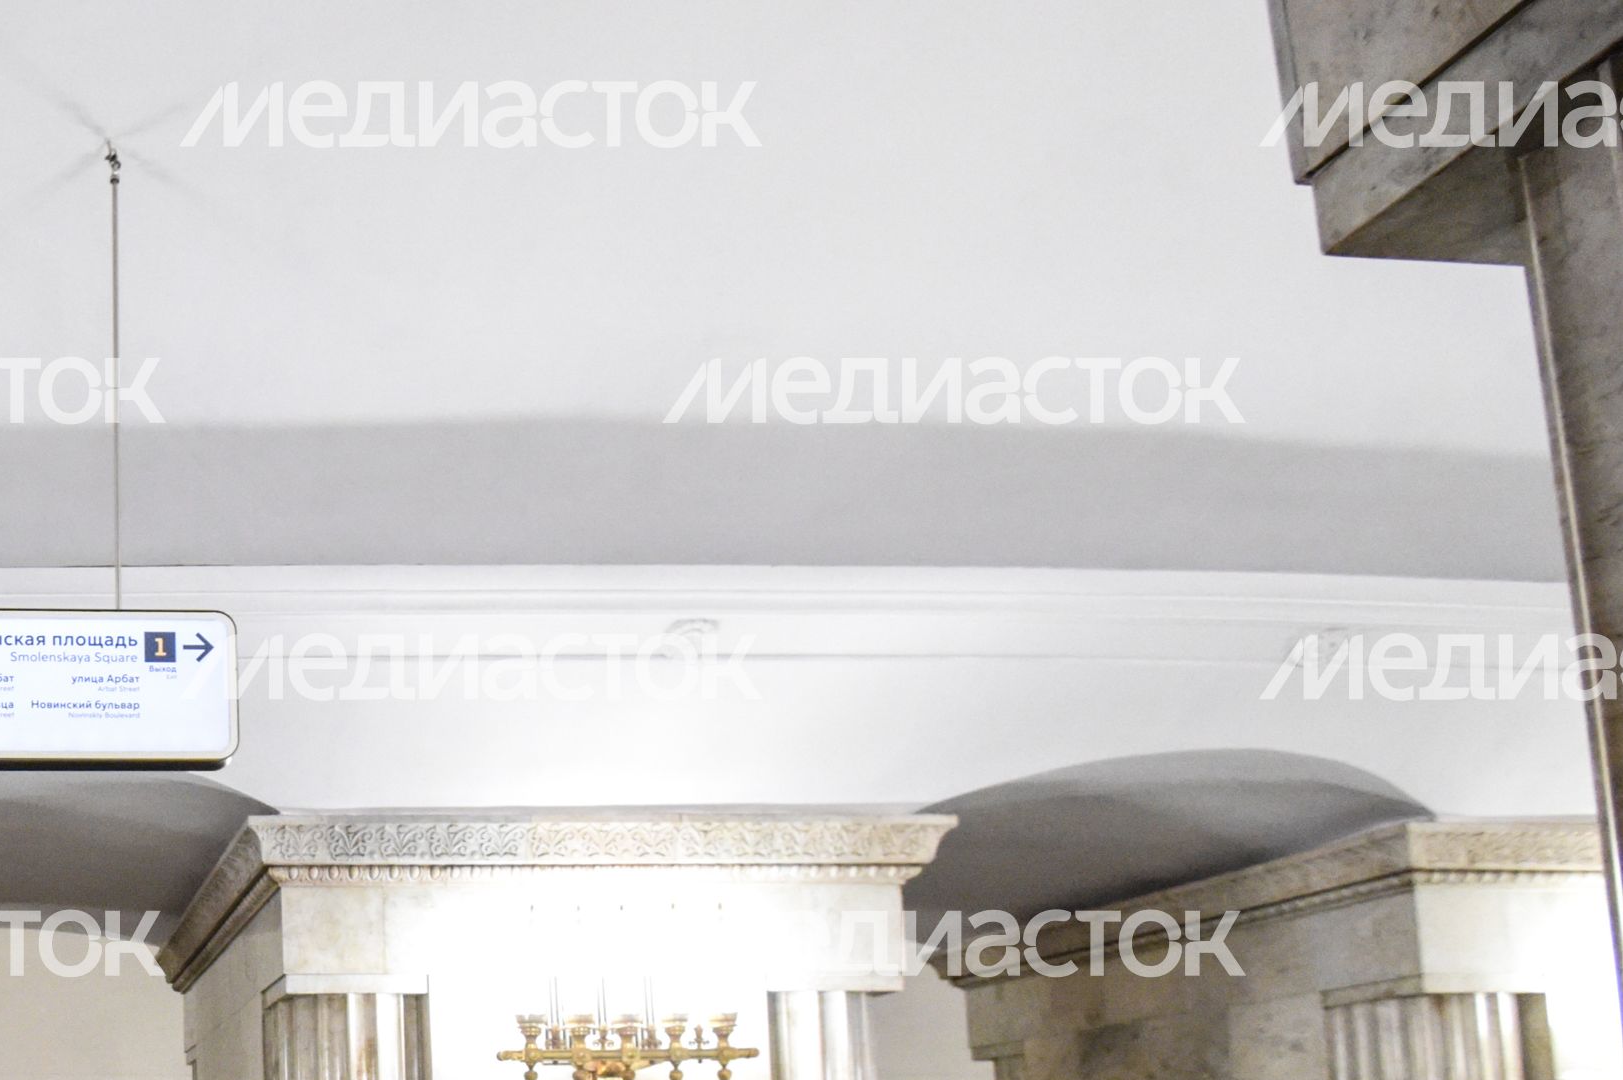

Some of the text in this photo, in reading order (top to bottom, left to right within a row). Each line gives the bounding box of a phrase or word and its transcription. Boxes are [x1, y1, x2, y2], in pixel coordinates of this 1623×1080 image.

[53, 634, 138, 649] площадь
[155, 638, 166, 656] 1
[10, 651, 138, 664] Smolenskaya Square
[71, 675, 140, 685] улица Арбат
[31, 700, 140, 711] Новинский бульвар
